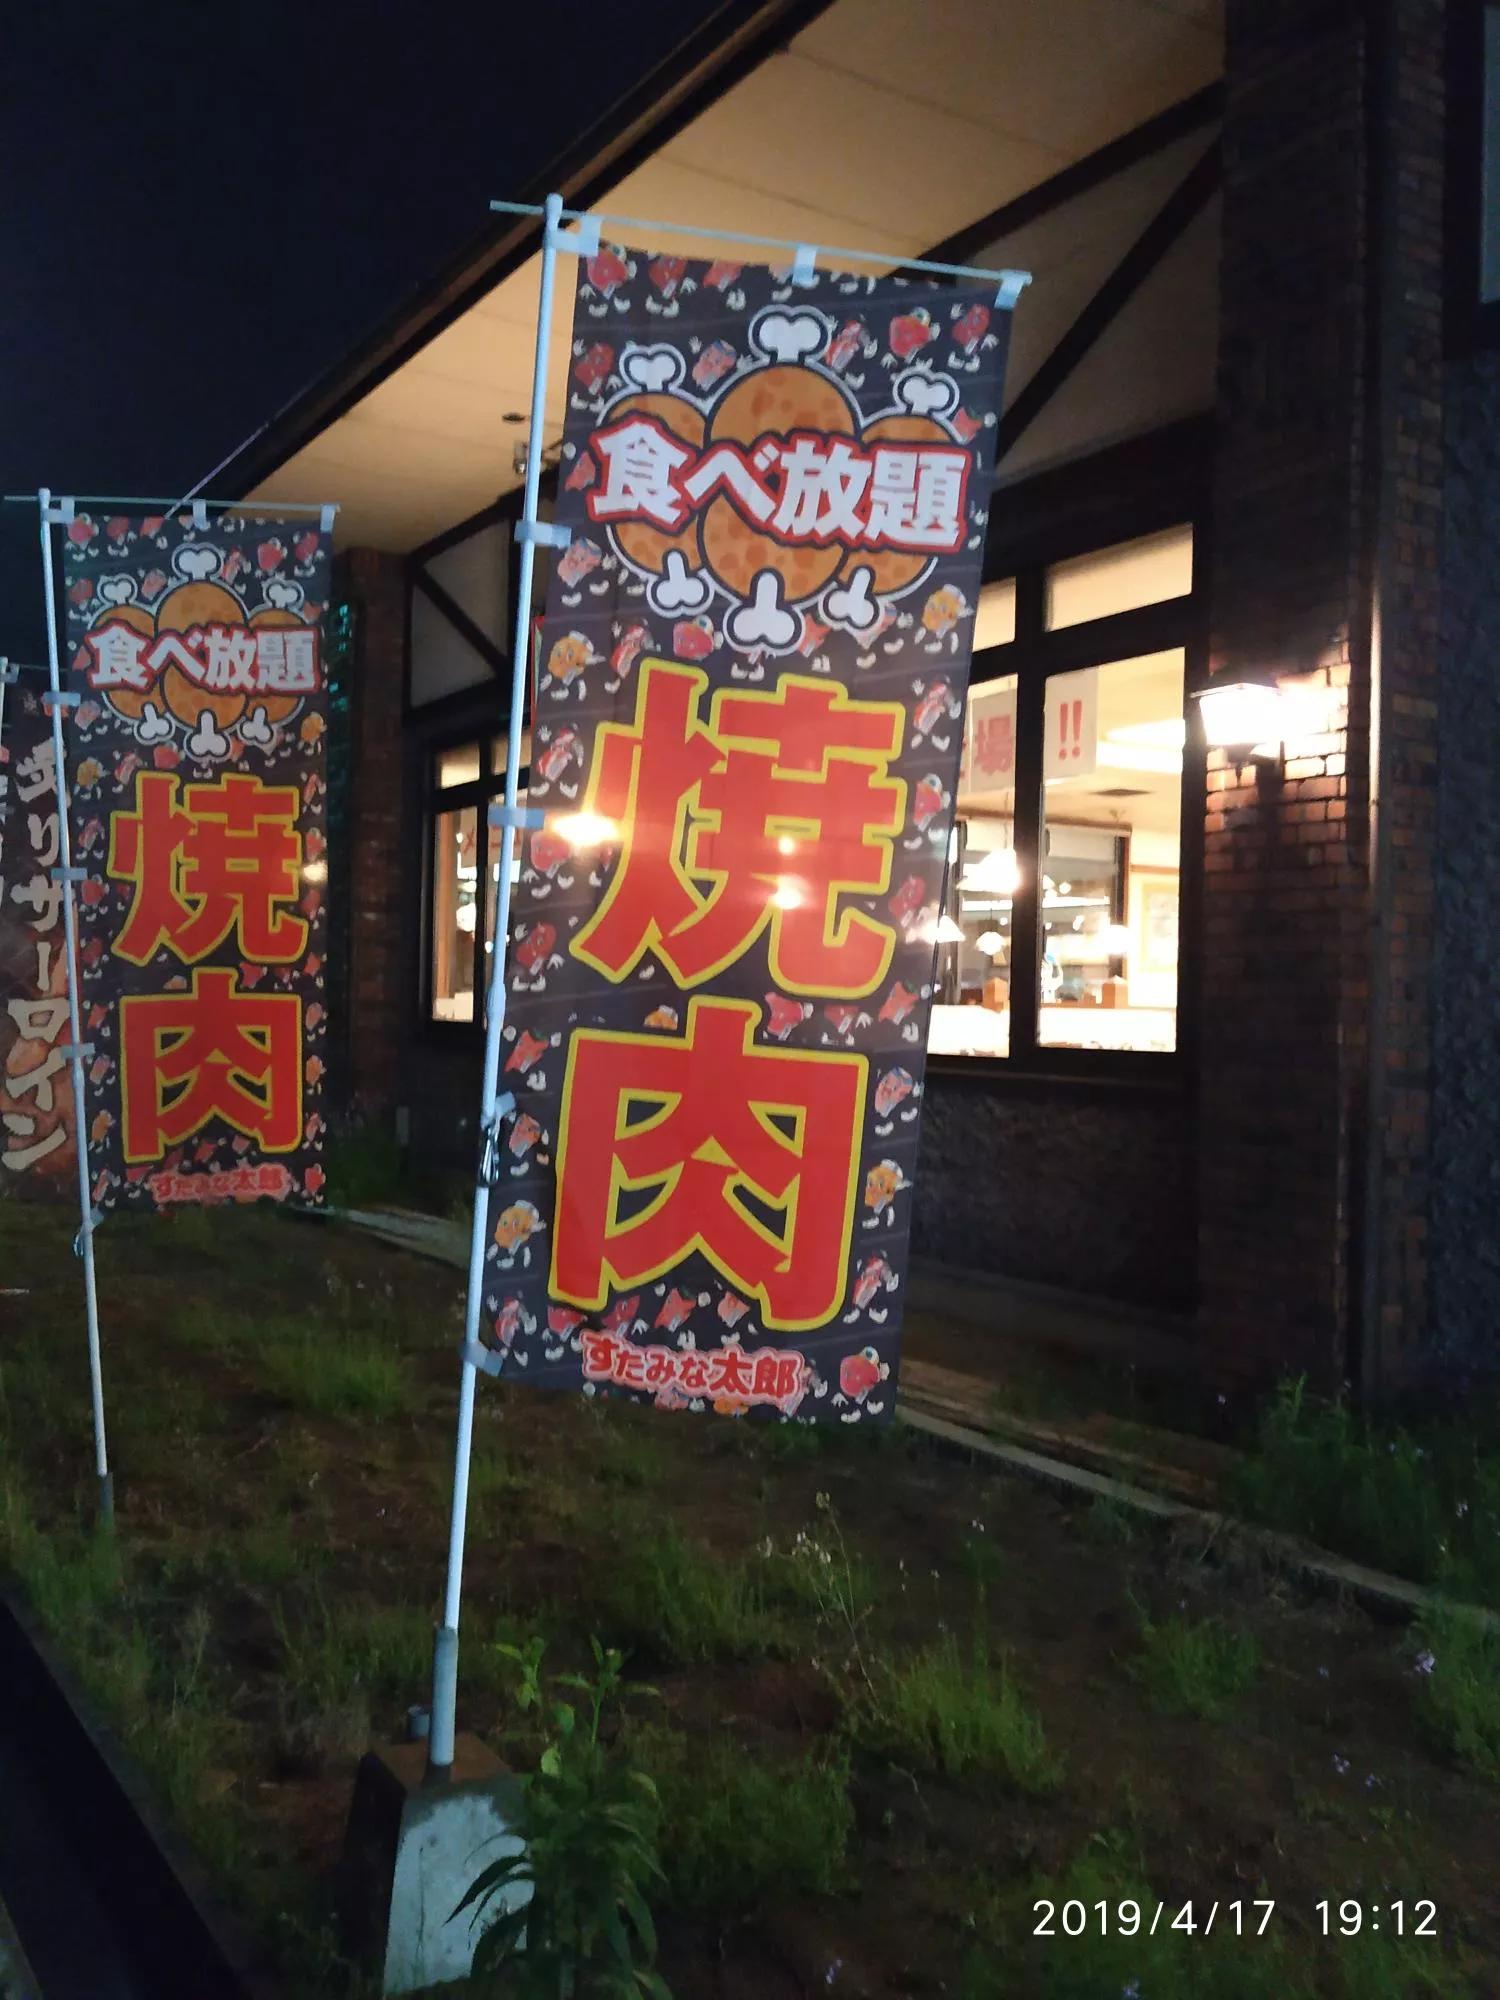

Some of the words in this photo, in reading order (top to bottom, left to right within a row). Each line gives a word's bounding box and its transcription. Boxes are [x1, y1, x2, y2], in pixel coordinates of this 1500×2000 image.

[592, 413, 970, 549] 食べ放題
[86, 621, 319, 694] 食べ放題
[107, 771, 309, 1164] 焼肉
[548, 657, 909, 1331] 焼肉
[582, 1332, 801, 1401] すたみな太郎
